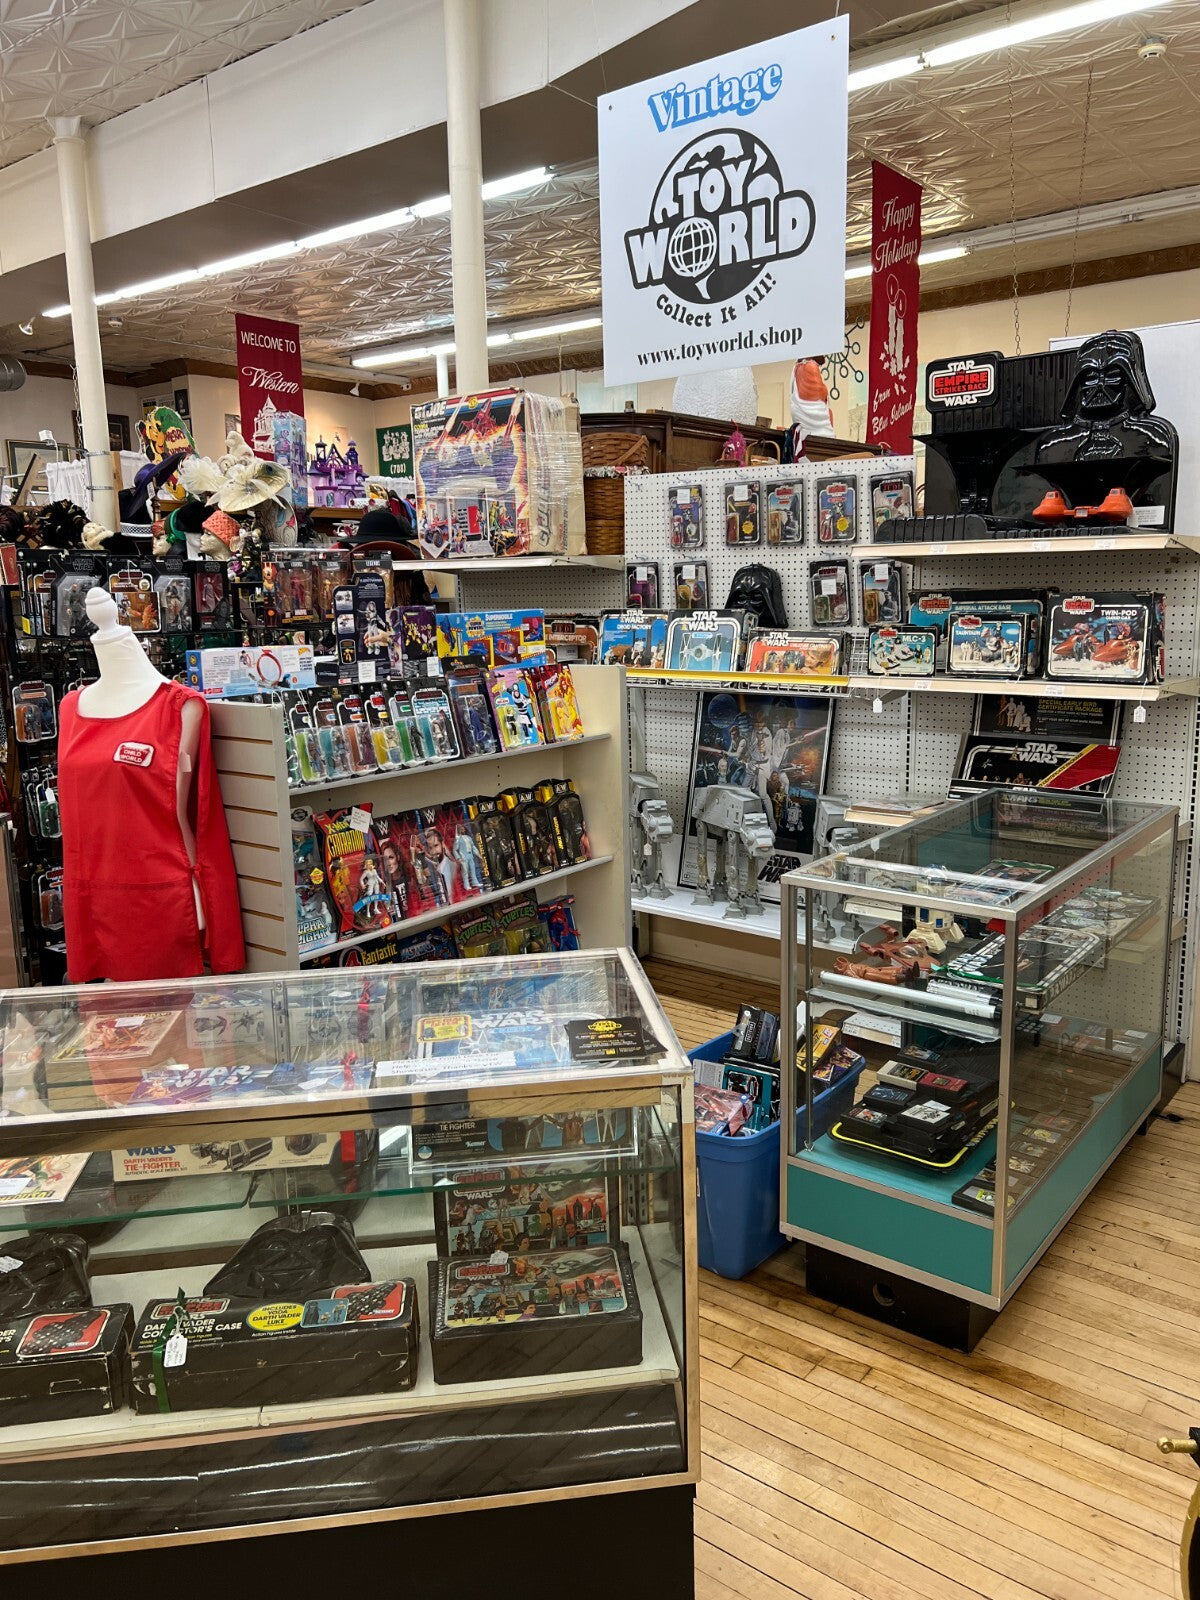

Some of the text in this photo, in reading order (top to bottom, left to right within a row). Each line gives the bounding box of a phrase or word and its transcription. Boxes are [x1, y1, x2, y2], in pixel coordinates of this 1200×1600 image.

[648, 63, 783, 133] Vintage
[676, 159, 752, 220] TOY
[882, 197, 915, 234] Happy
[626, 193, 814, 285] WORLD
[875, 237, 918, 274] Holidays
[656, 271, 777, 328] Collect It All!
[240, 330, 297, 354] WELCOME TO
[637, 325, 803, 367] www.toyworld.shop
[947, 360, 976, 371] STAR
[241, 365, 299, 394] Western
[935, 372, 988, 388] EMPIRE
[935, 382, 987, 395] STRIKES BACK
[944, 395, 978, 407] WARS
[425, 401, 446, 417] JOE
[692, 611, 718, 620] STAR
[688, 621, 719, 631] WARS
[769, 632, 789, 640] STAR
[902, 635, 926, 643] MLC-3
[767, 639, 789, 647] WARS
[1024, 742, 1058, 753] STAR
[120, 754, 142, 763] WORLD
[1018, 752, 1059, 764] WARS
[325, 821, 349, 833] X-MEN
[497, 905, 535, 928] TURTLES
[459, 920, 493, 943] TURTLES
[361, 942, 398, 964] Fantastic
[481, 1010, 546, 1019] STAR
[471, 1016, 554, 1029] WARS
[183, 1065, 252, 1078] STAR
[449, 1122, 476, 1131] FIGHTER
[126, 1145, 176, 1157] WARS
[124, 1161, 181, 1172] TIE-FIGHTER
[466, 1191, 493, 1199] WARS
[262, 1304, 297, 1312] INCLUDES
[144, 1319, 216, 1332] DAR VADER
[215, 1322, 242, 1331] CASE
